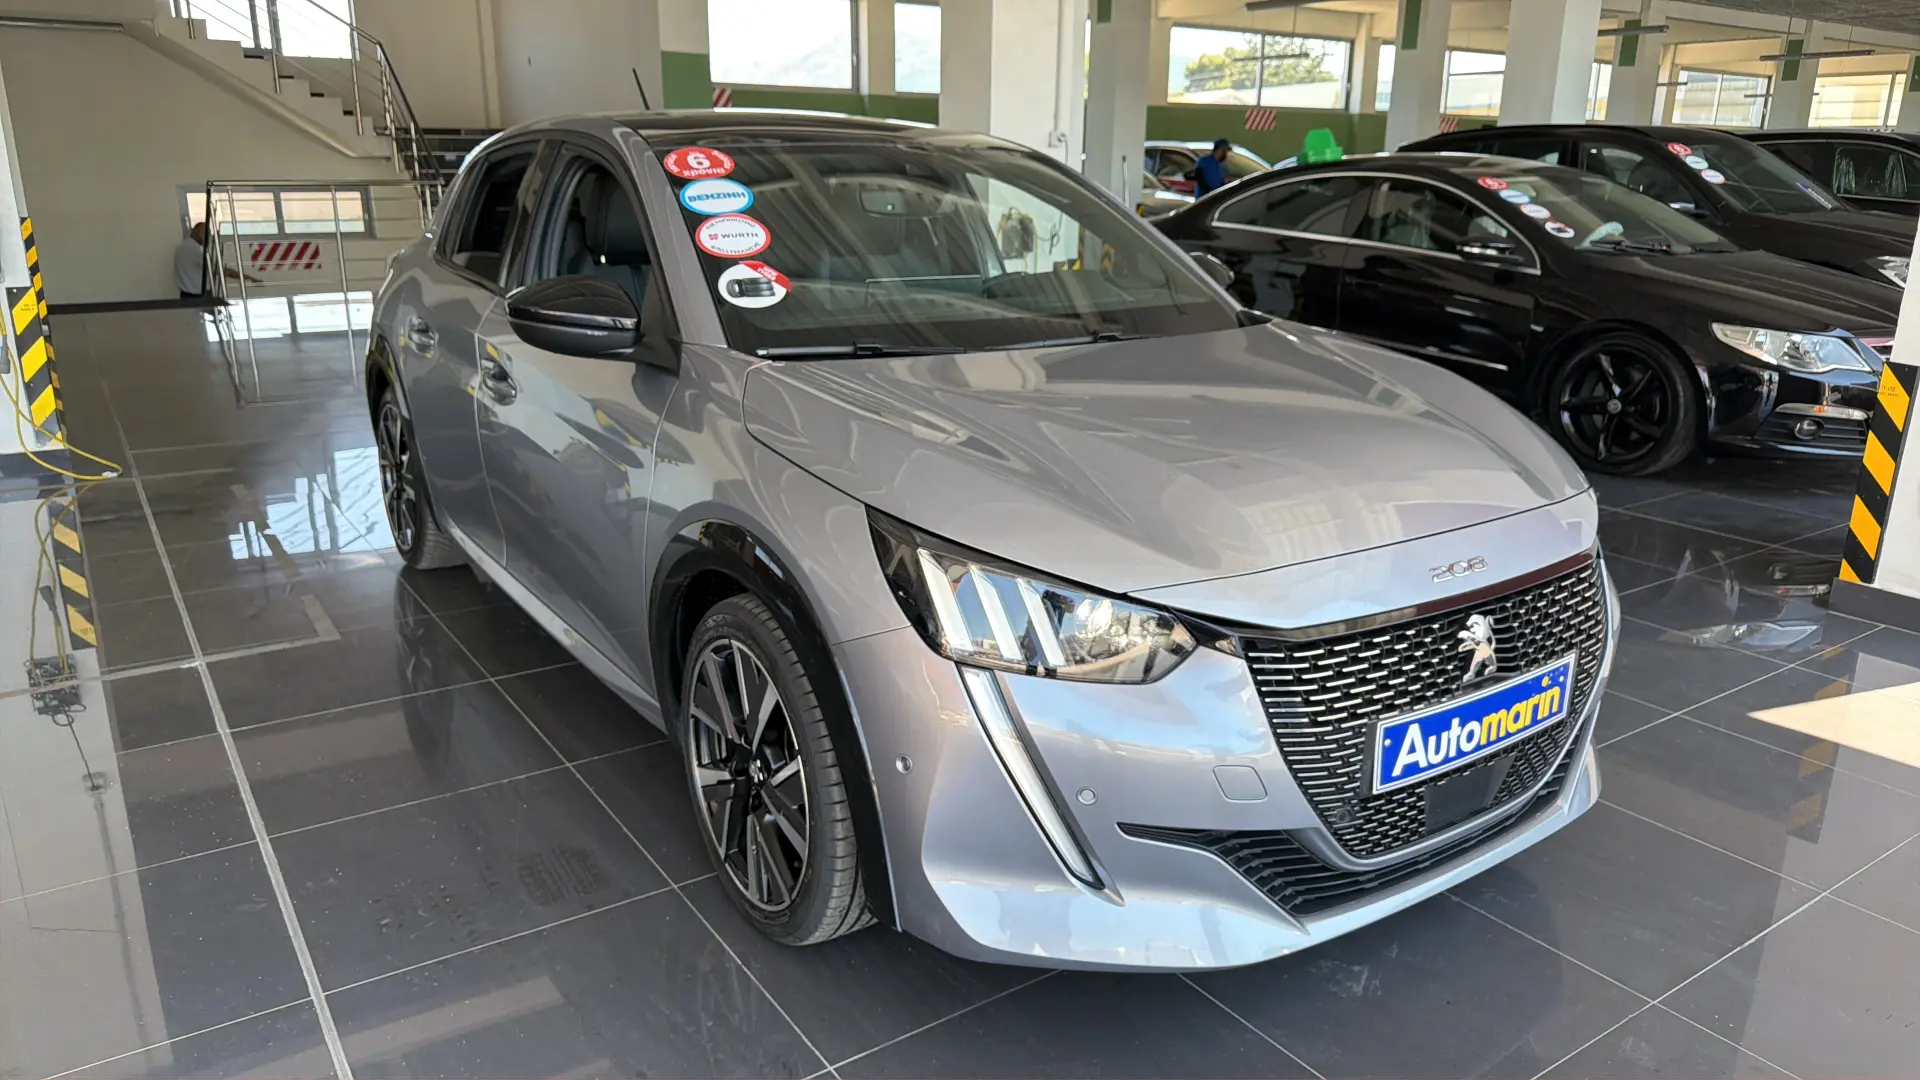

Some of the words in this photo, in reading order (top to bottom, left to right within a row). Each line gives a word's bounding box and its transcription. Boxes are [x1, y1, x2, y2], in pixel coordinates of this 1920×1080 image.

[687, 151, 711, 169] 6
[1428, 555, 1488, 584] 208
[1391, 676, 1561, 778] Automarin
